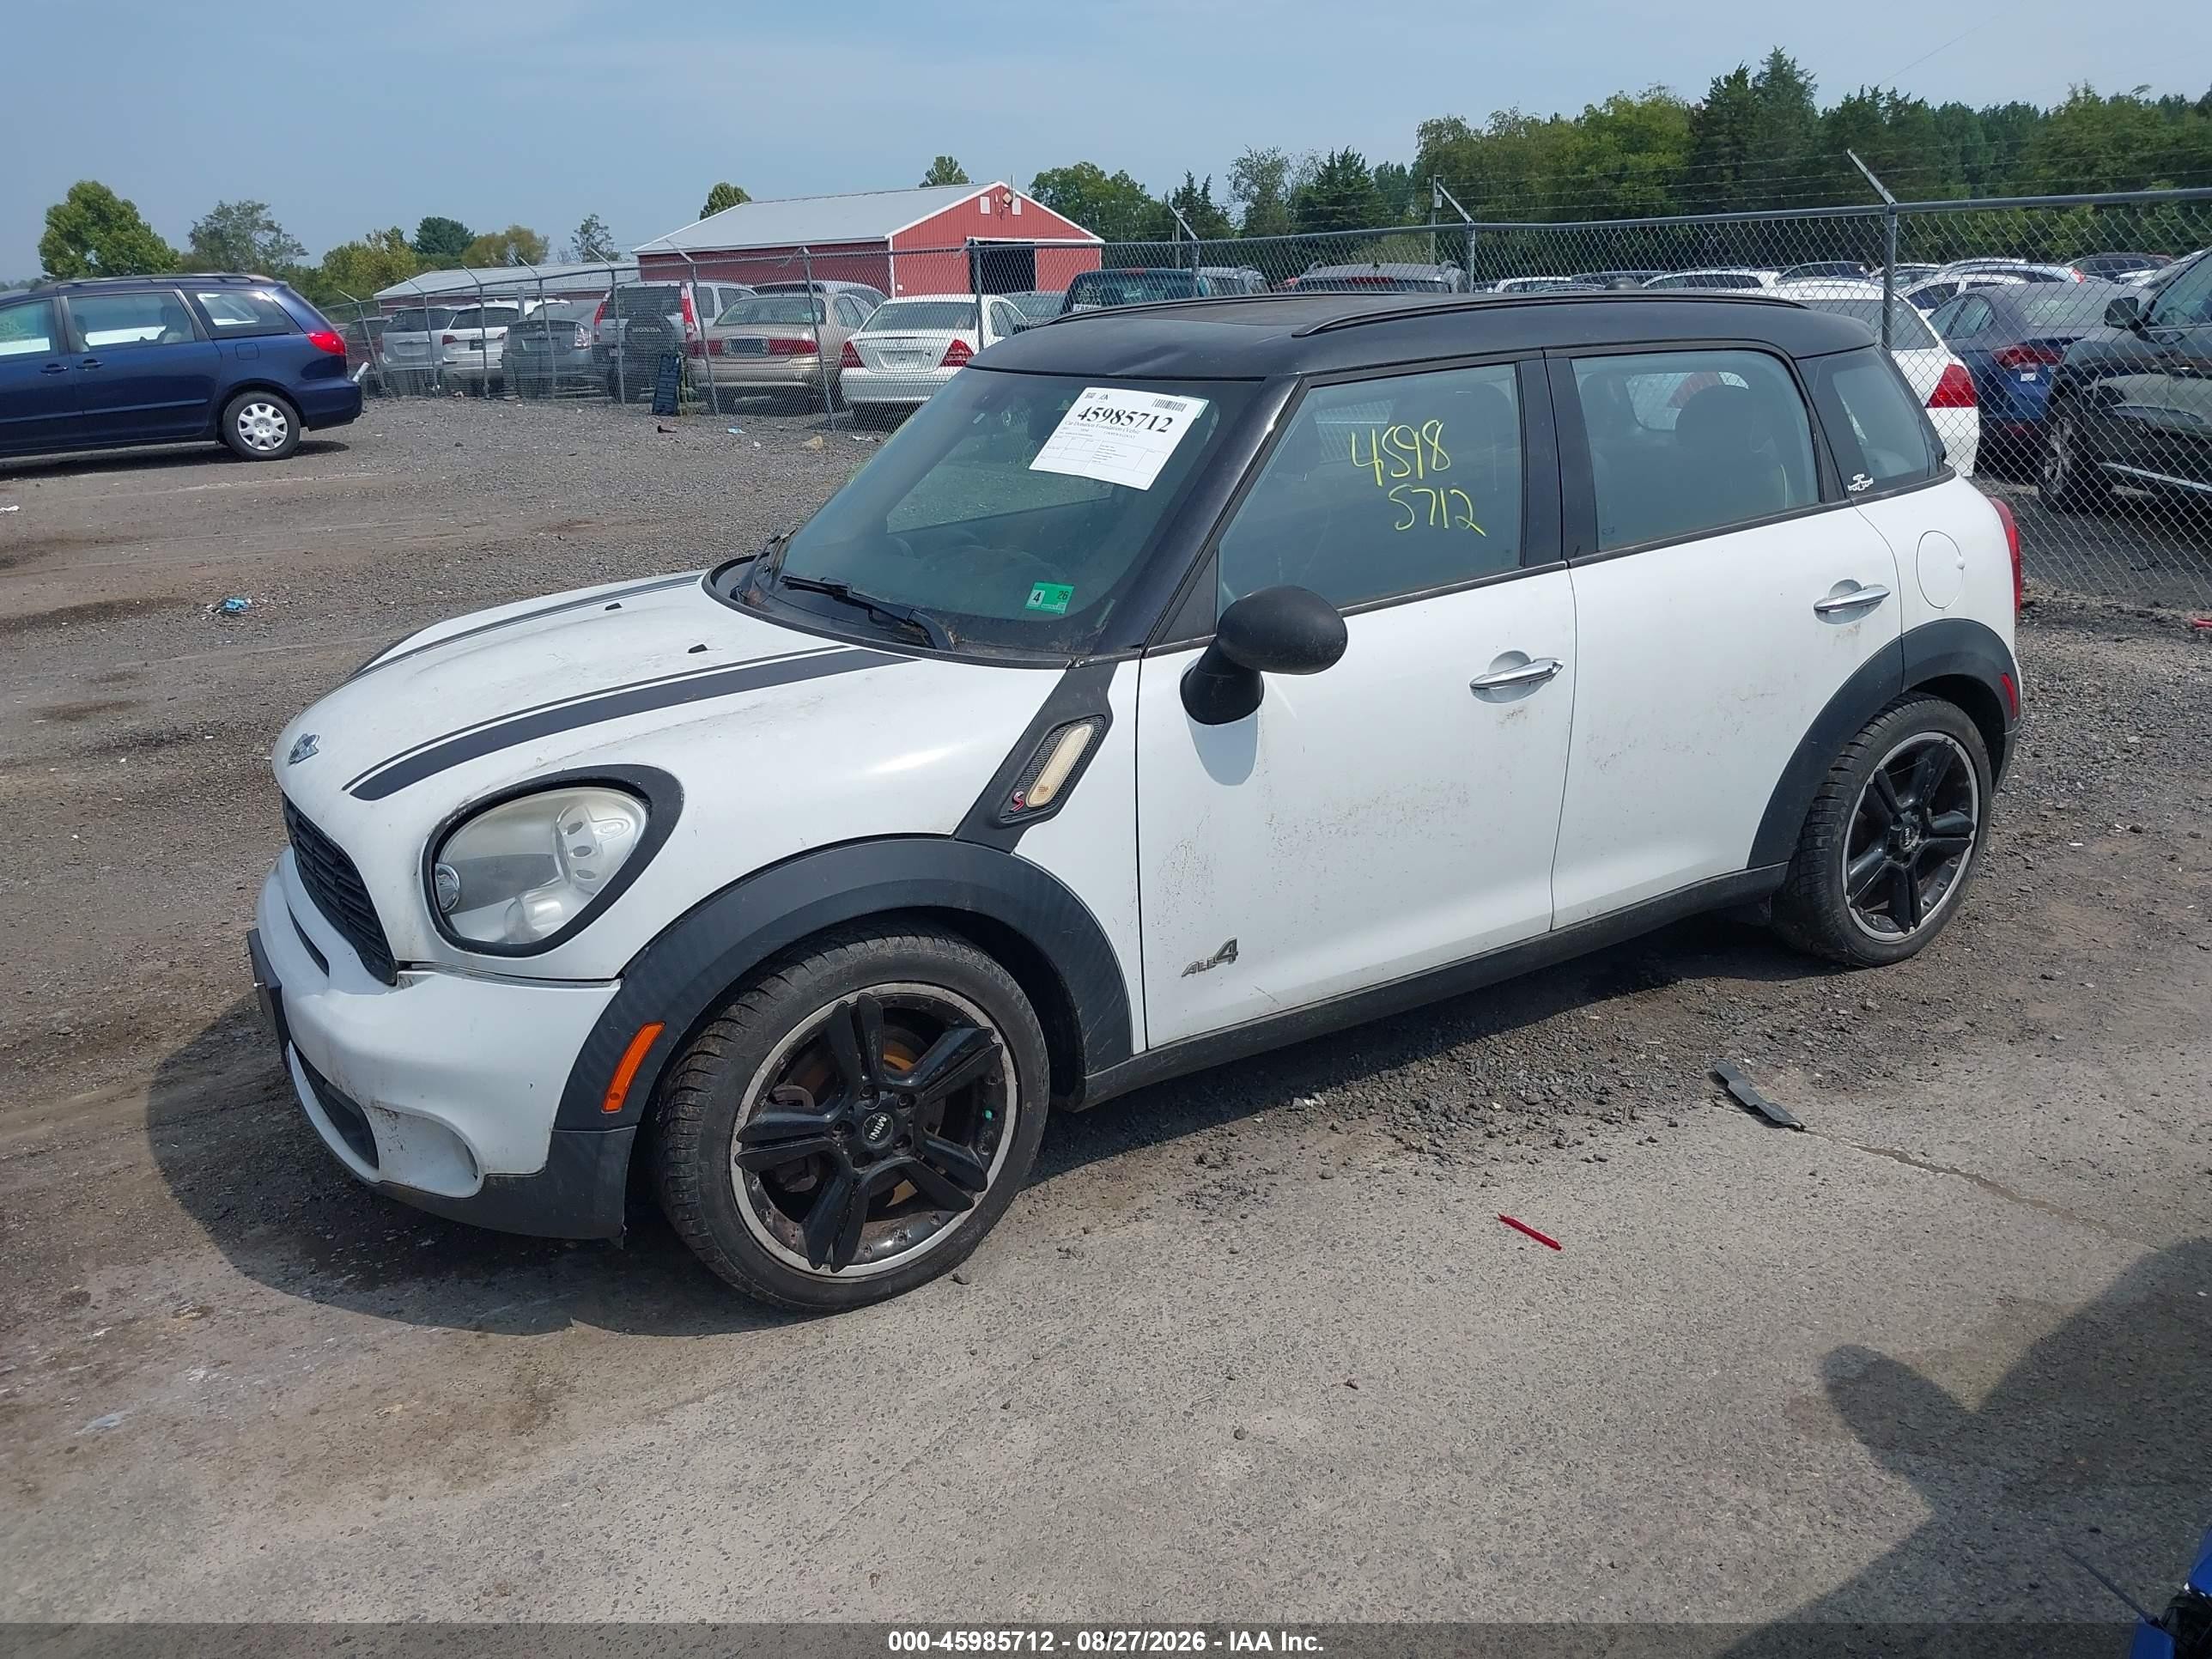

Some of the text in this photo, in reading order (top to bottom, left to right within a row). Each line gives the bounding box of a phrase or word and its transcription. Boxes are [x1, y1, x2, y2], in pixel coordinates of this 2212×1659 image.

[1078, 406, 1173, 433] 45985712
[1350, 419, 1451, 487] 4598
[1388, 483, 1487, 537] 5712
[1033, 591, 1042, 603] 4
[868, 1115, 887, 1141] MINI
